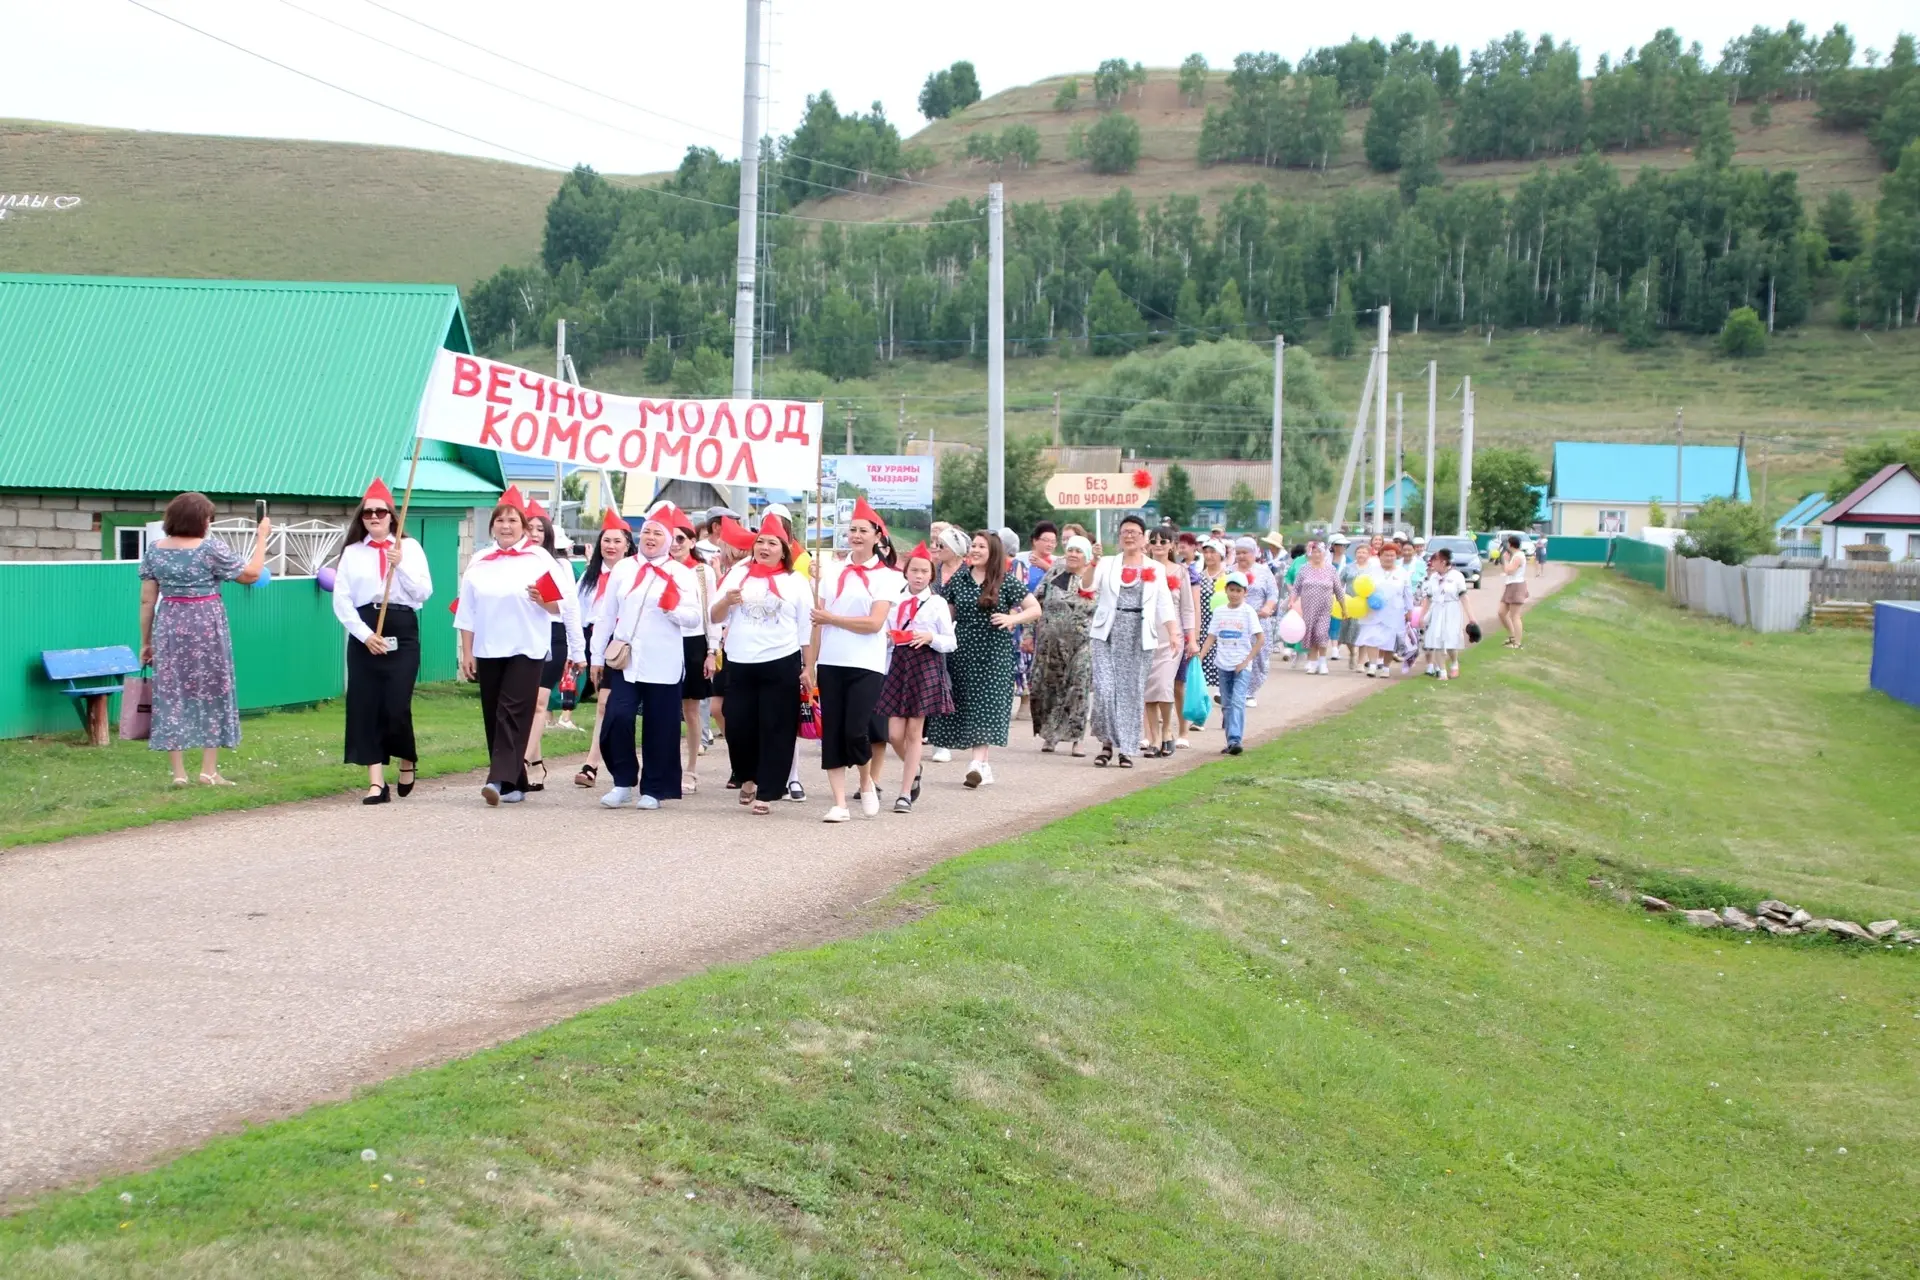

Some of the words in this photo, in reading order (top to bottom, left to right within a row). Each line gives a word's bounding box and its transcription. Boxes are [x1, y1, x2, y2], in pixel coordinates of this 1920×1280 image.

[452, 356, 603, 420] ВЕЧНО
[638, 399, 809, 446] МОЛОД
[479, 405, 758, 483] КОМСОМОЛ
[866, 464, 882, 473] ТАУ
[885, 464, 920, 473] УРАМЫ
[1084, 493, 1139, 505] УРАМДАР
